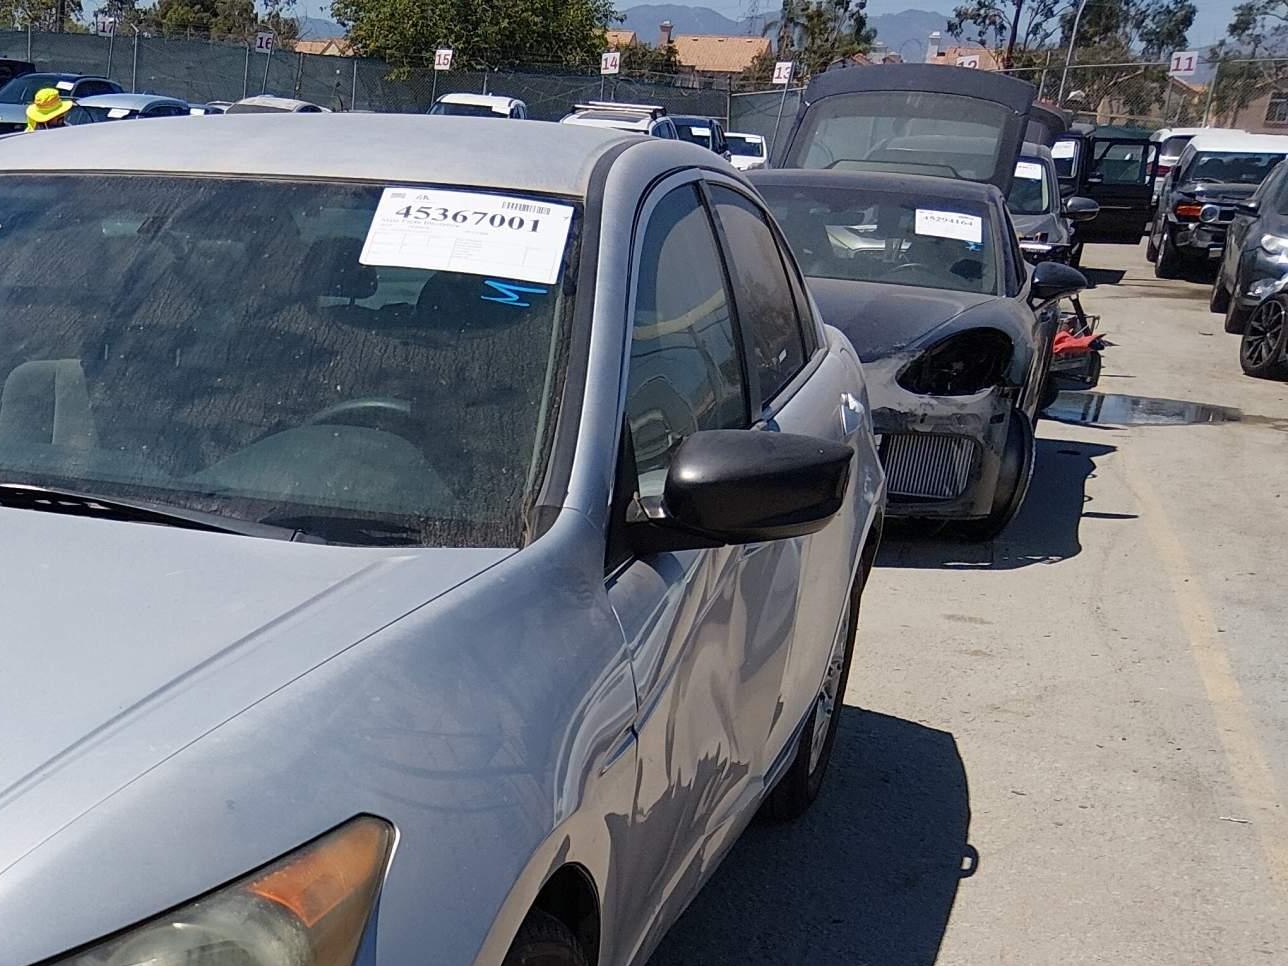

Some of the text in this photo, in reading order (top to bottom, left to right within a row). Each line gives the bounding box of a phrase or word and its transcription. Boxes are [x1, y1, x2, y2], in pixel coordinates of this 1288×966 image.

[100, 21, 114, 33] 17
[257, 37, 272, 49] 16
[436, 54, 450, 66] 15
[602, 57, 617, 70] 14
[1172, 56, 1194, 71] 11
[775, 66, 790, 80] 13
[396, 205, 541, 232] 45367001
